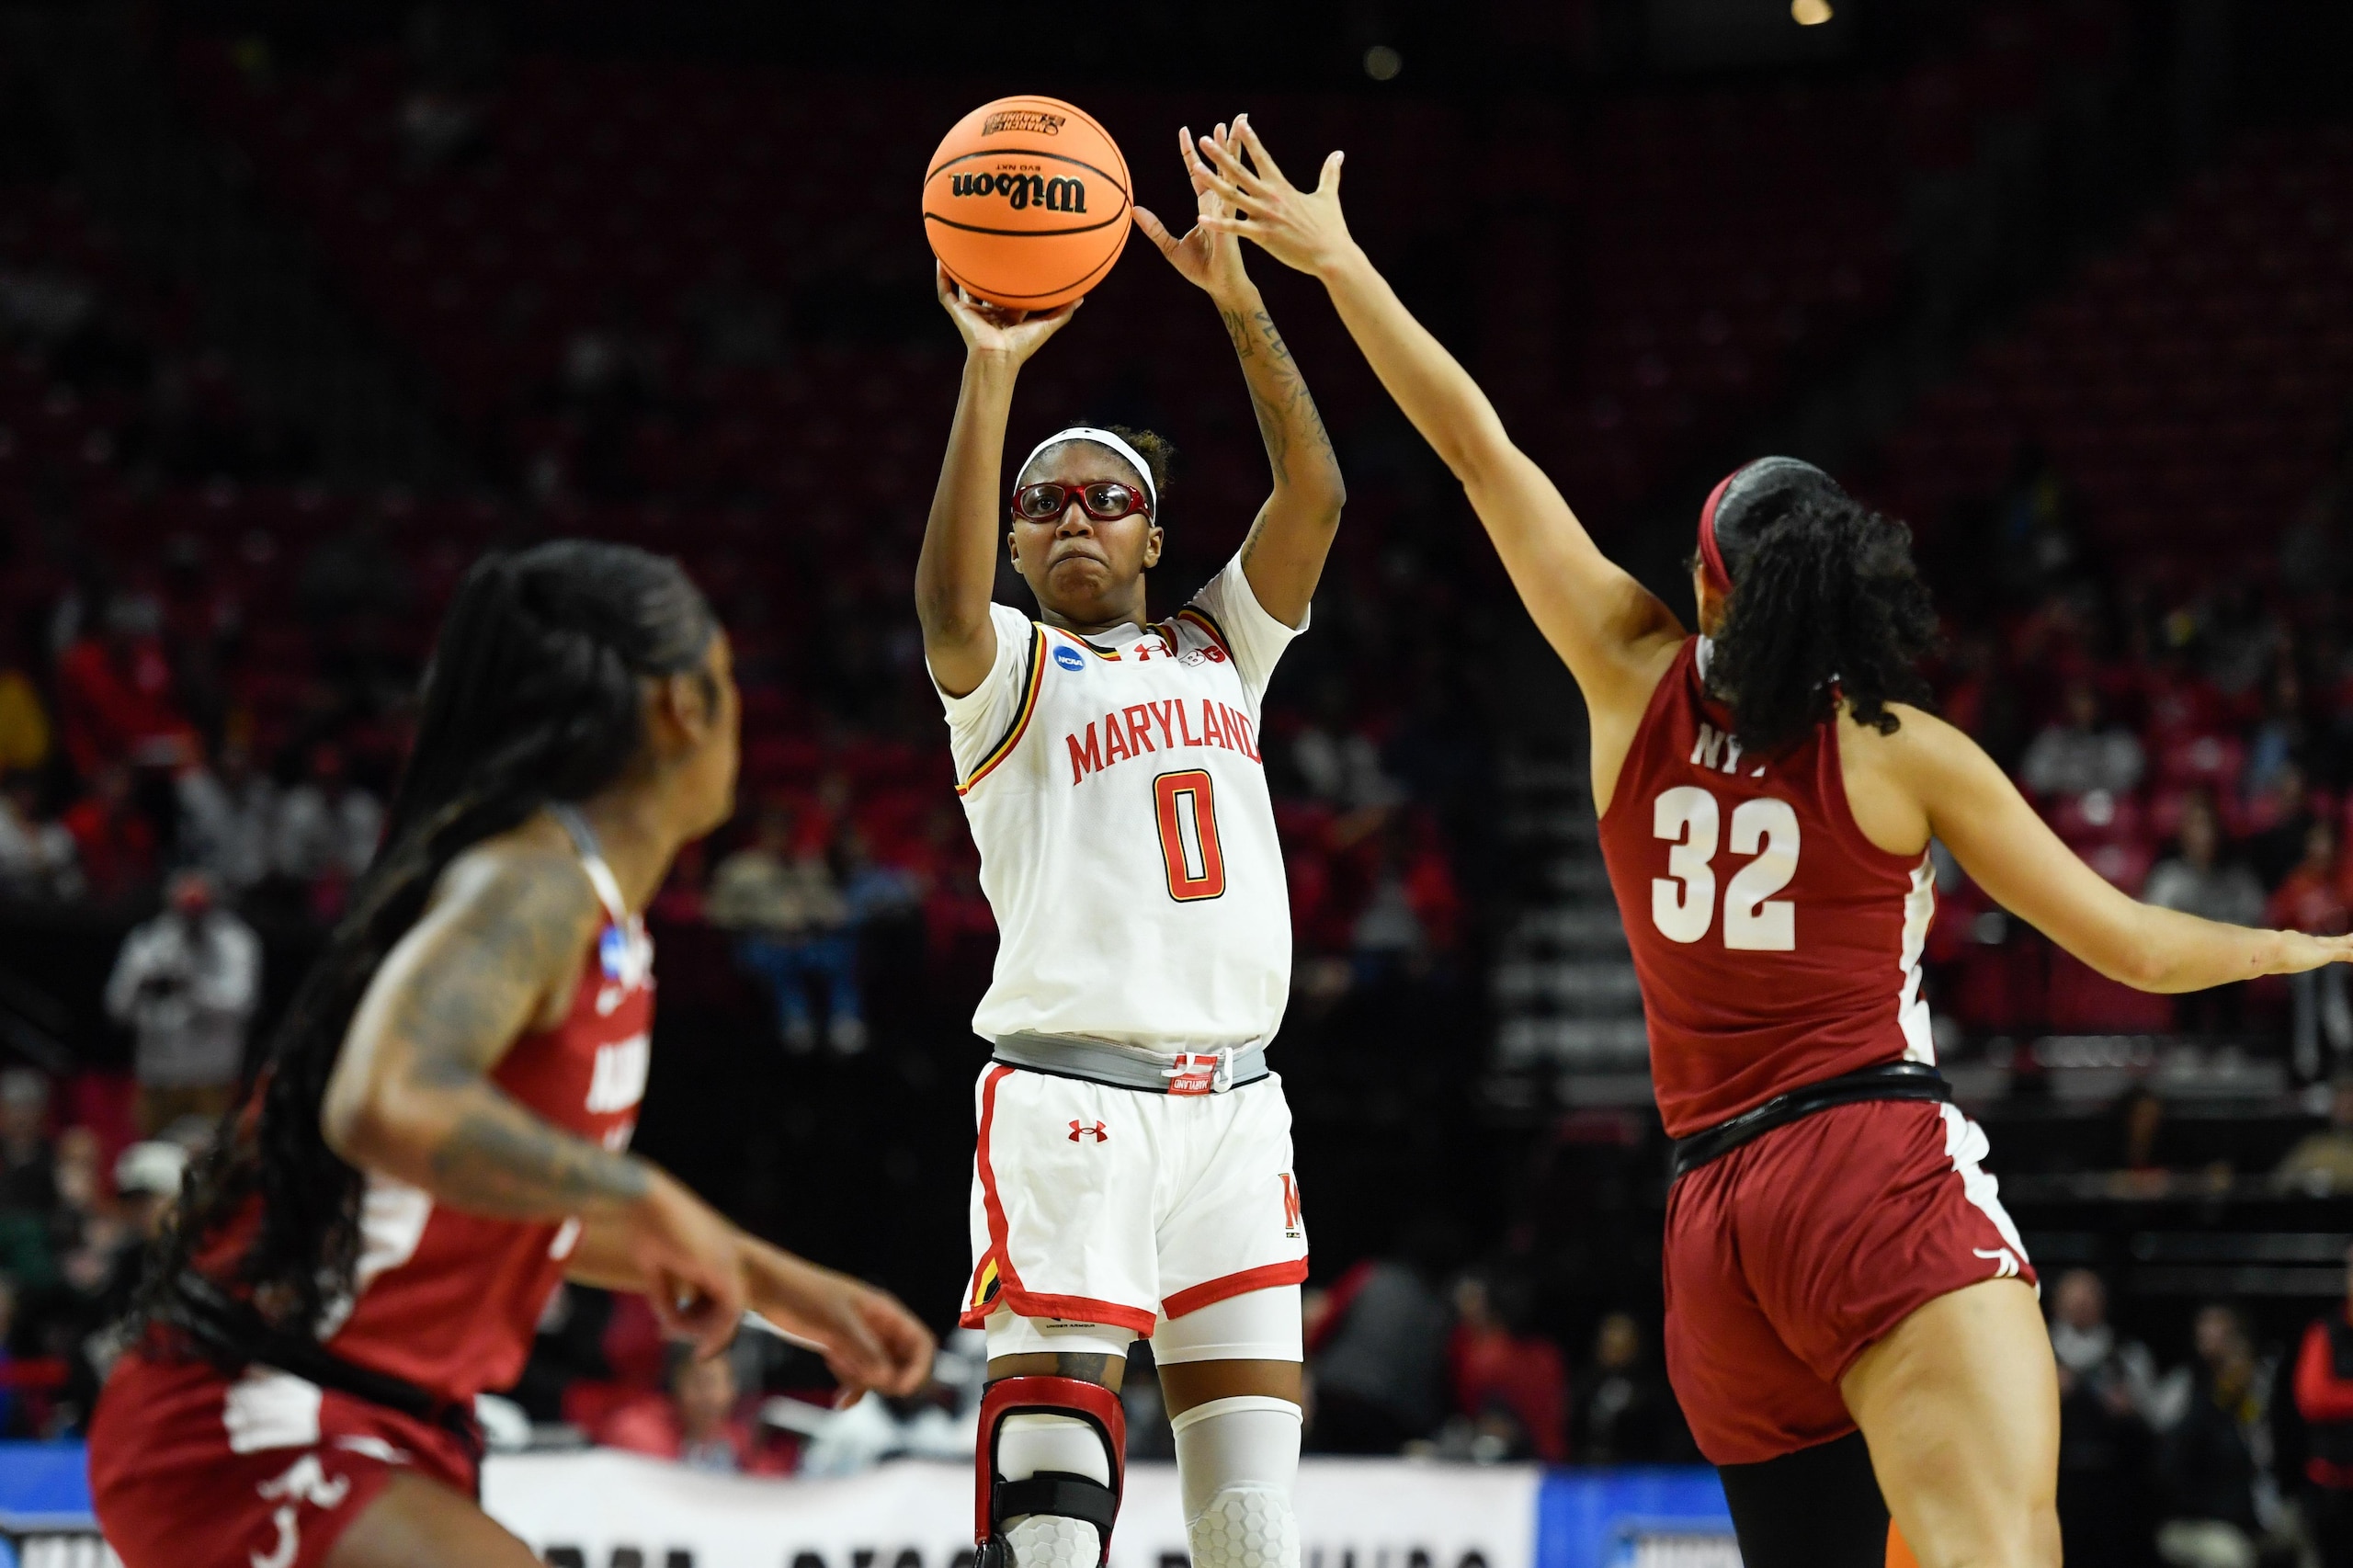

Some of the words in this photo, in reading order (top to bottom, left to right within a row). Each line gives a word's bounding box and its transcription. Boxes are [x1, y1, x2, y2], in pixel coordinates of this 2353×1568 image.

[951, 172, 1087, 213] Wilson
[1058, 654, 1084, 666] NCAA
[1065, 699, 1263, 787] MARYLAND
[1689, 722, 1767, 778] NY
[1153, 768, 1226, 903] 0
[1652, 786, 1802, 950] 32
[1174, 1078, 1209, 1091] MARYLAND
